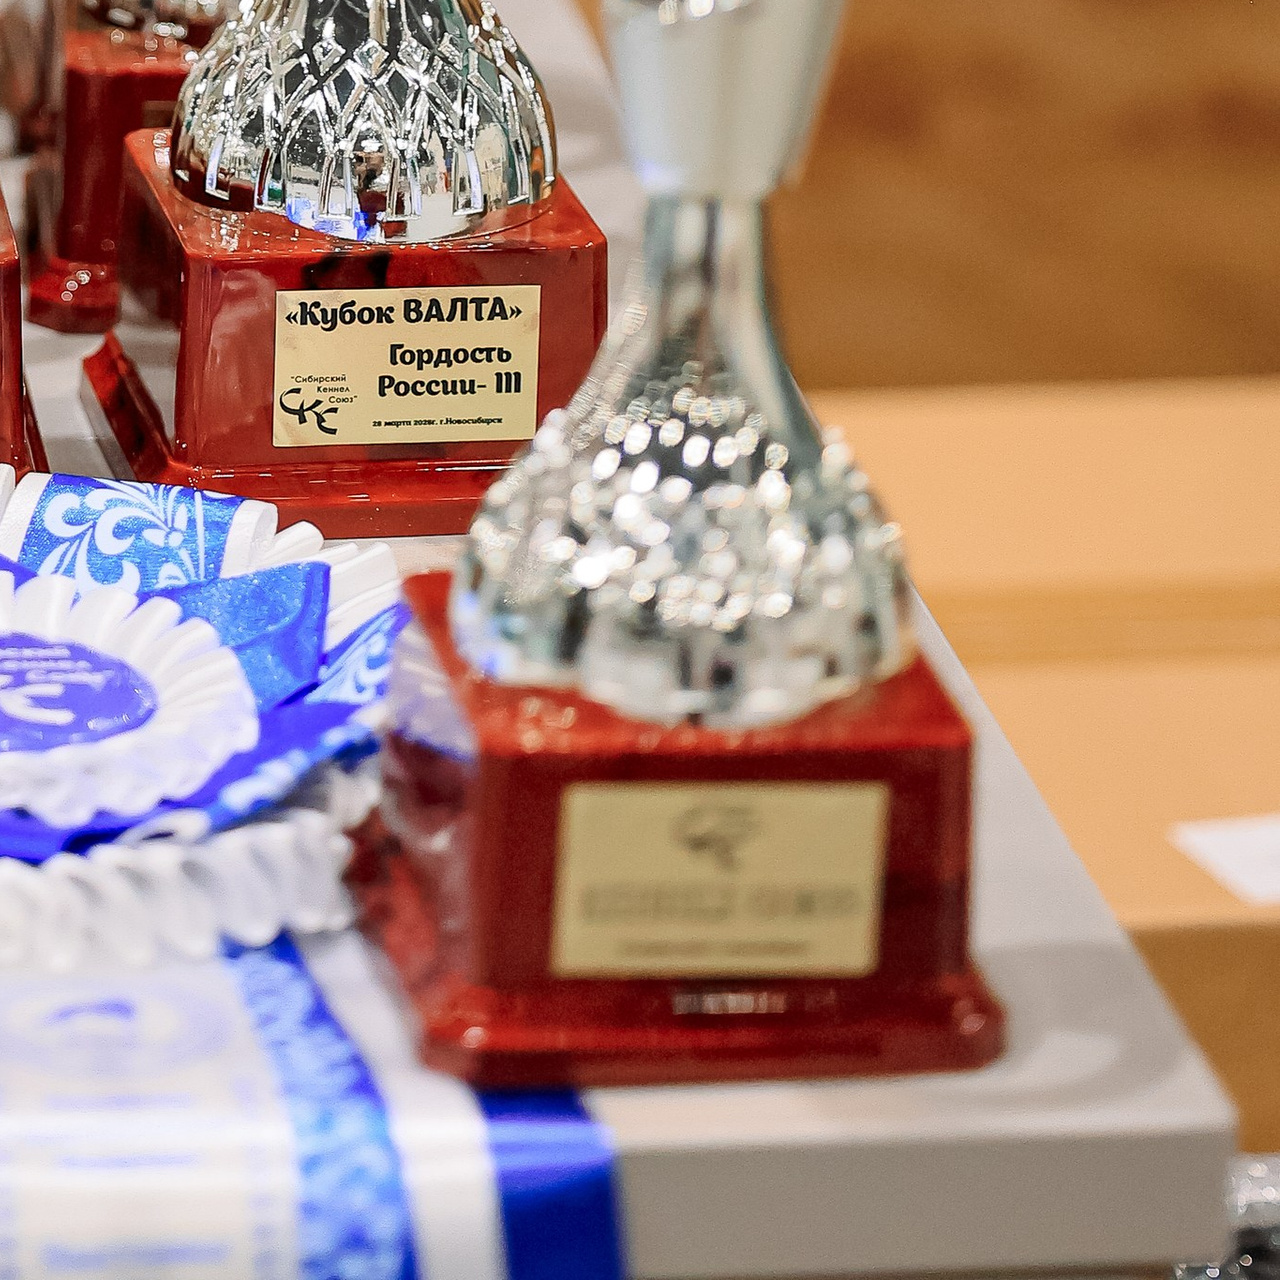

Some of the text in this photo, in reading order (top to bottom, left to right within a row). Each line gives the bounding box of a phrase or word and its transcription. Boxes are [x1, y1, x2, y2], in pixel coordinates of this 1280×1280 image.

[286, 297, 522, 331] «Кубок ВАЛТА»
[390, 344, 512, 370] Гордость
[291, 374, 346, 383] "Сибирский
[495, 372, 521, 393] III
[329, 396, 357, 404] Союз"
[384, 419, 412, 428] марта
[440, 417, 502, 426] г.Новосибирск
